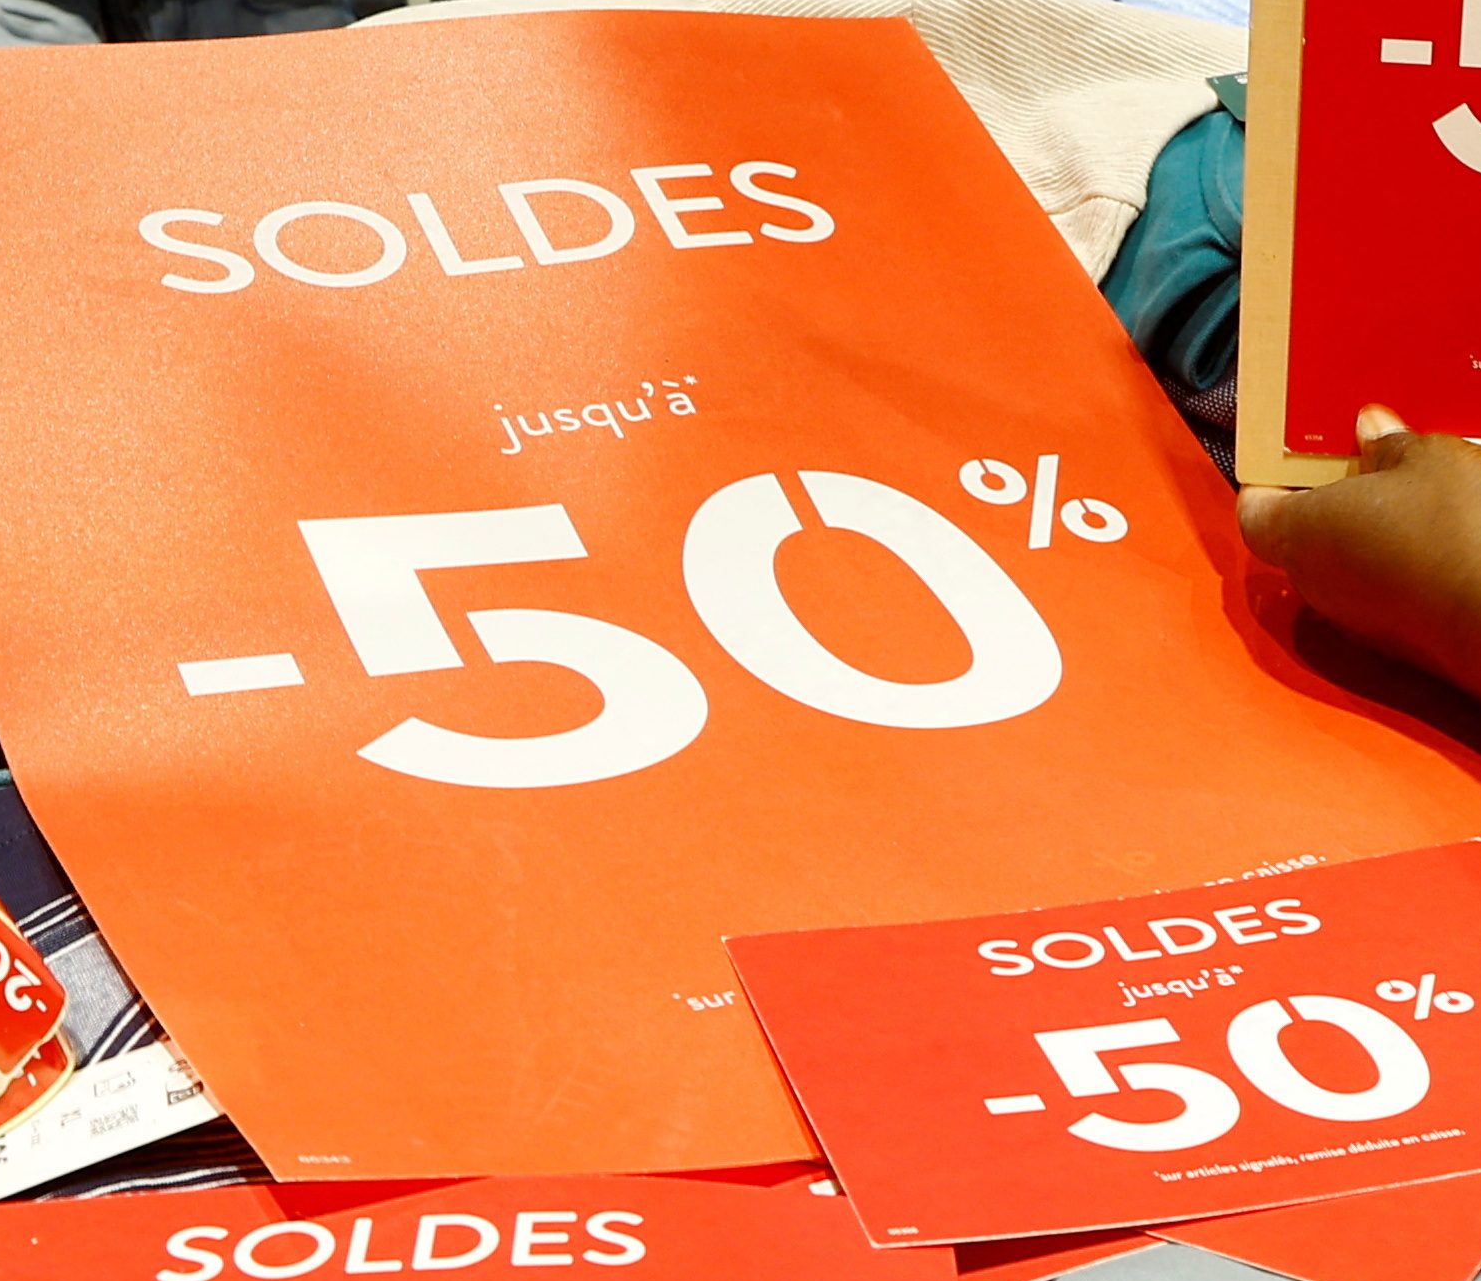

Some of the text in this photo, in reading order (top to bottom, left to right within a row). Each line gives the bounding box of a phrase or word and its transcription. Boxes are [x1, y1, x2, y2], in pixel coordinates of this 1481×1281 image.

[137, 160, 836, 295] SOLDES
[177, 454, 1129, 789] -50%
[978, 899, 1322, 978] SOLDES
[984, 972, 1475, 1153] -50%
[1186, 1162, 1239, 1179] articles
[1299, 1146, 1347, 1162] remise
[1348, 1136, 1400, 1154] déduite
[1401, 1135, 1420, 1145] en
